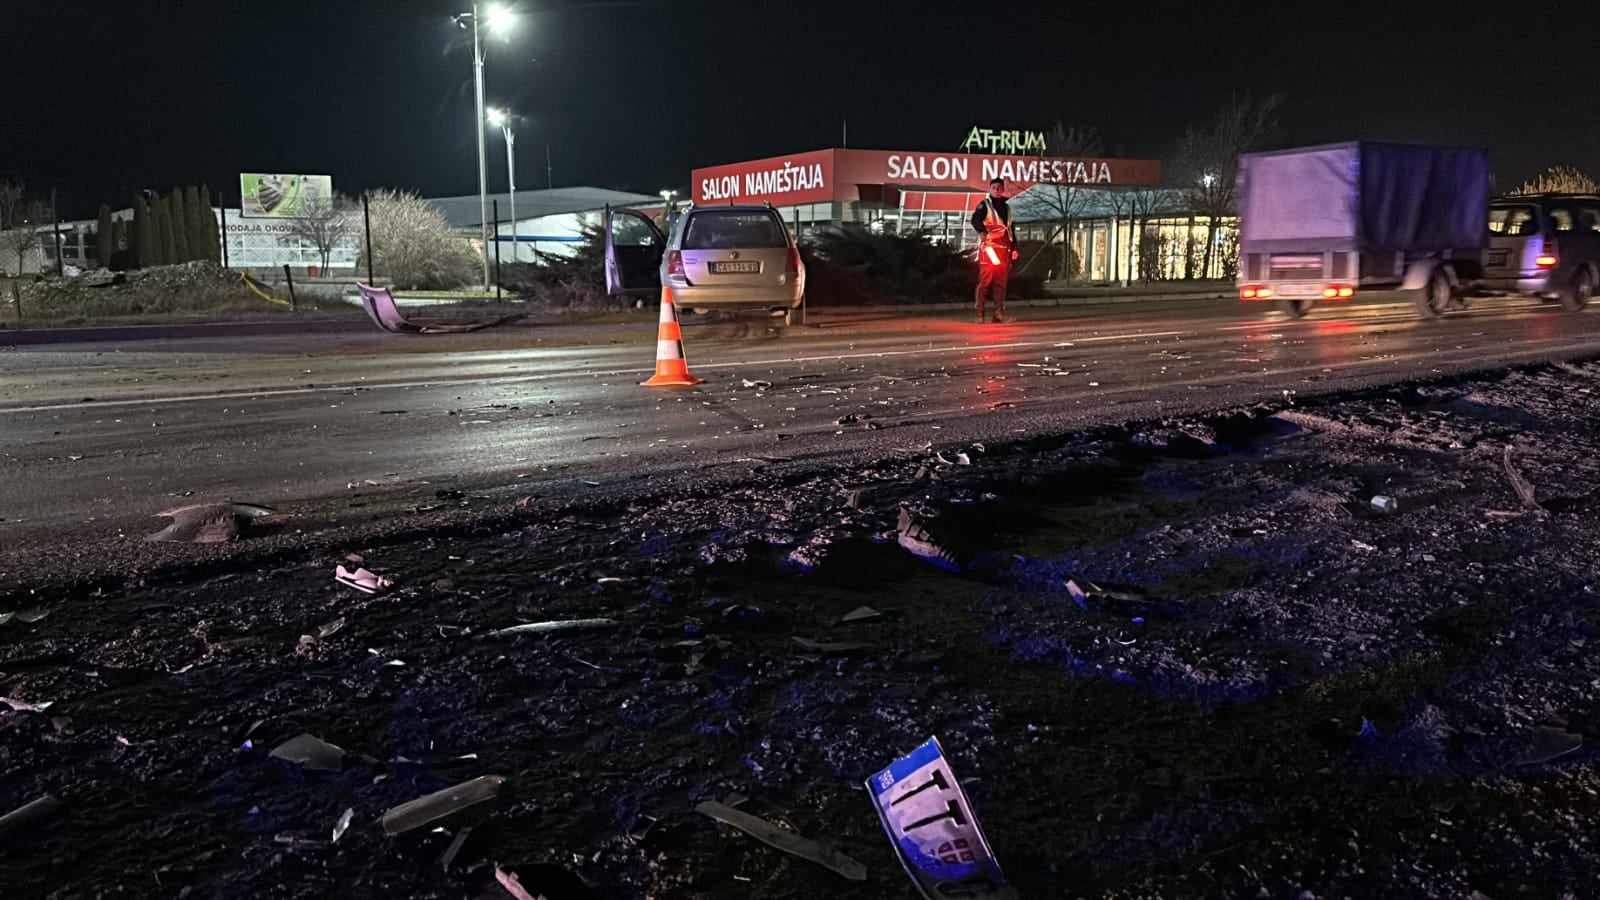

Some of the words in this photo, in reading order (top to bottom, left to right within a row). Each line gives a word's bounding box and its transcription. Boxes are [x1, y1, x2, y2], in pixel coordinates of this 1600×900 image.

[702, 175, 739, 201] SALON
[746, 161, 824, 196] NAMEŠTAJA
[887, 155, 968, 181] SALON
